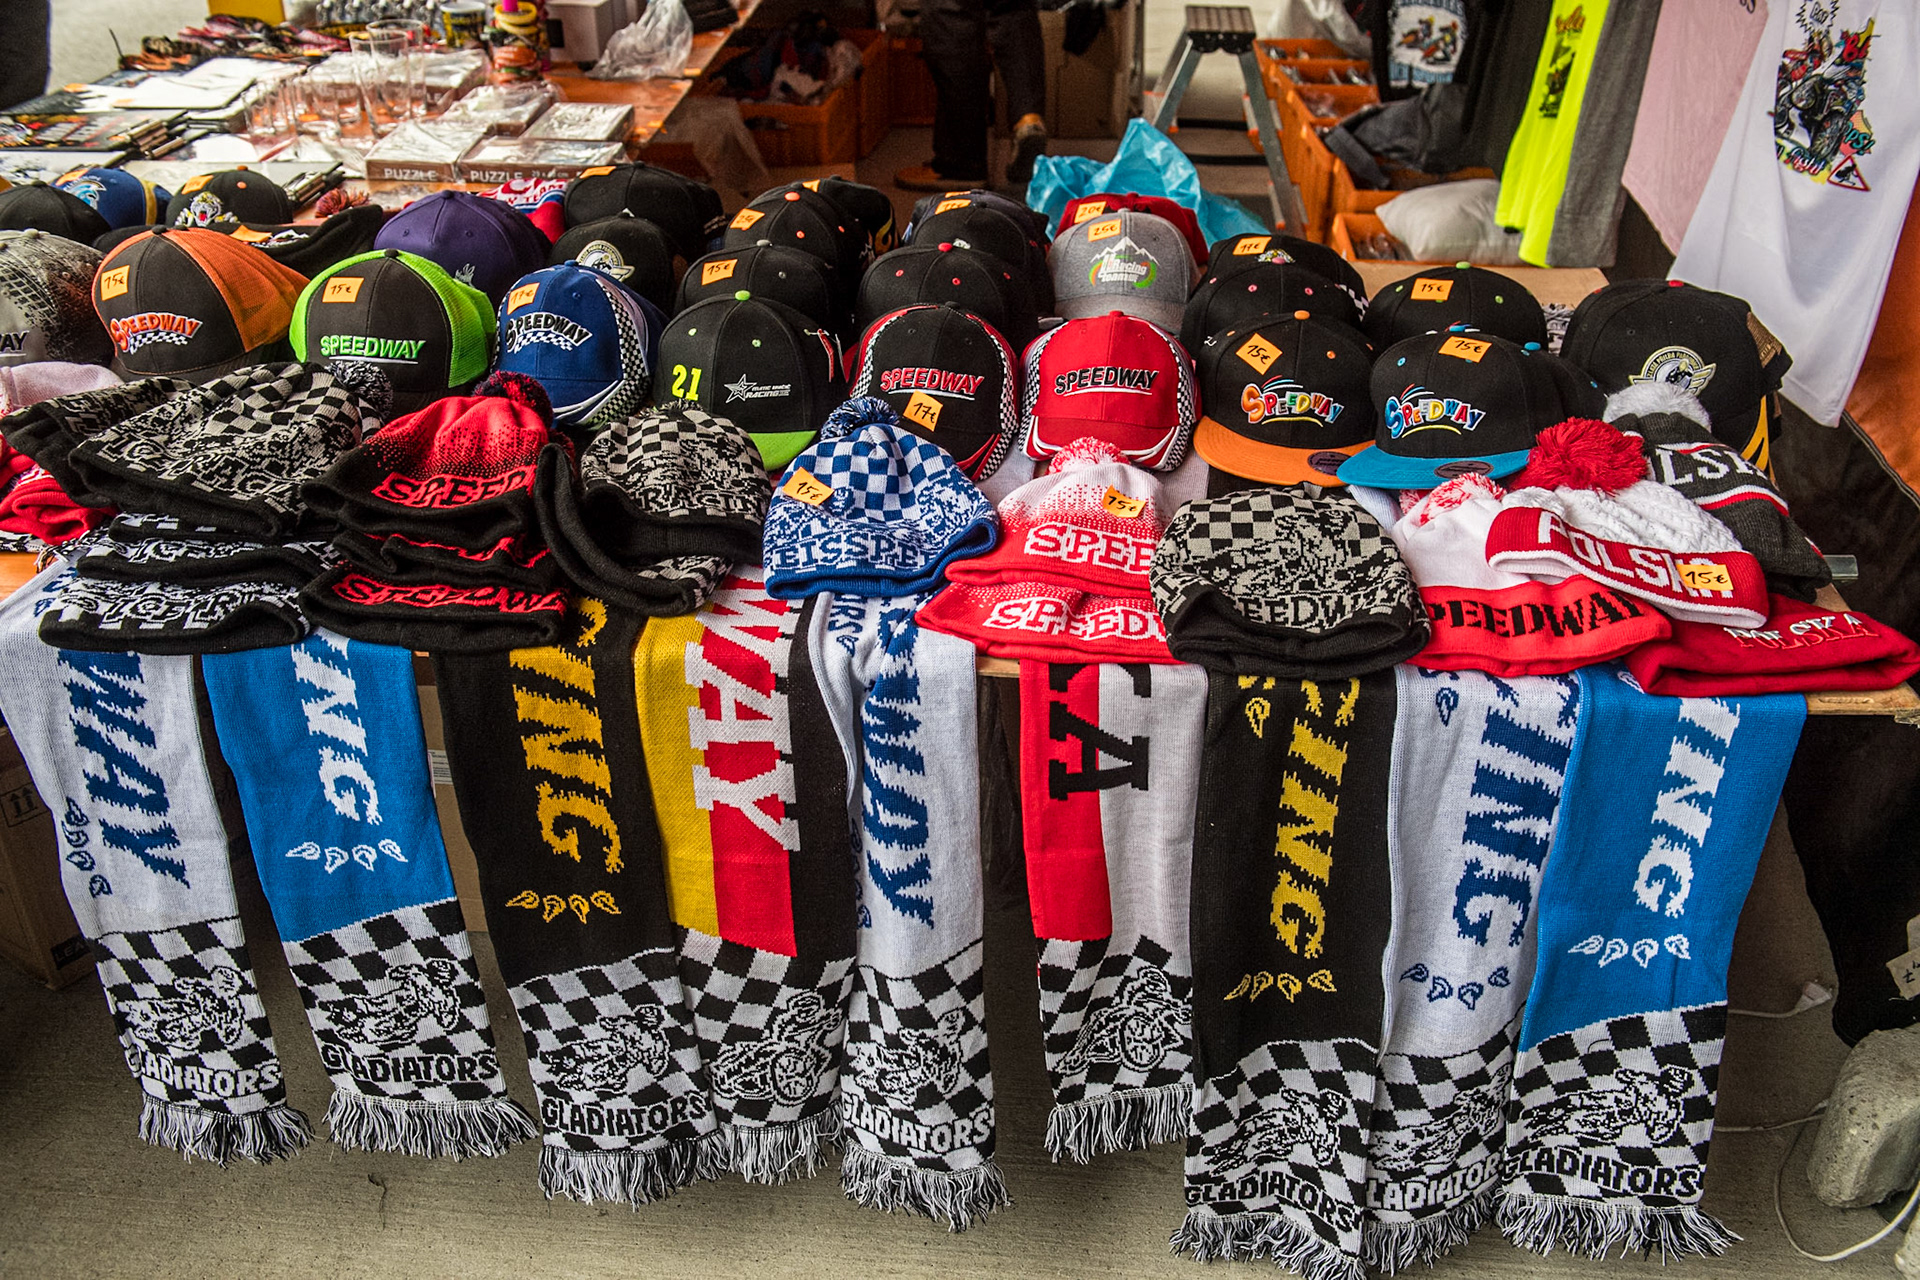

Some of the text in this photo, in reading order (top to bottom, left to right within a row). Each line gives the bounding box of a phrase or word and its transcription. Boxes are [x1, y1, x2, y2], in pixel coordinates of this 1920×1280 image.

[384, 168, 438, 182] PUZZLE
[470, 170, 523, 183] PUZZLE
[1094, 224, 1118, 236] 25€
[104, 272, 125, 289] 15€
[708, 262, 731, 275] 15€
[330, 283, 352, 295] 15€
[1421, 283, 1445, 293] 15€
[110, 312, 203, 353] SPEEDWAY
[505, 312, 593, 353] SPEEDWAY
[320, 335, 426, 359] SPEEDWAY
[1247, 344, 1271, 365] 15€
[1455, 340, 1483, 354] 15€
[671, 364, 702, 401] 21
[880, 367, 985, 393] SPEEDWAY
[1054, 366, 1160, 395] SPEEDWAY
[746, 391, 780, 399] RACING
[1241, 383, 1344, 424] SPEEDWAY
[913, 402, 937, 424] 17€
[1385, 396, 1486, 439] SPEEDWAY
[796, 482, 823, 500] 15€
[1108, 495, 1137, 512] 15€
[1685, 571, 1729, 585] 15€
[1723, 613, 1880, 650] POLSKA
[127, 1042, 282, 1098] GLADIATORS
[321, 1043, 499, 1084] GLADIATORS
[542, 1091, 707, 1138] GLADIATORS
[842, 1092, 993, 1153] GLADIATORS
[1502, 1146, 1701, 1197] GLADIATORS
[1185, 1171, 1362, 1232] GLADIATORS
